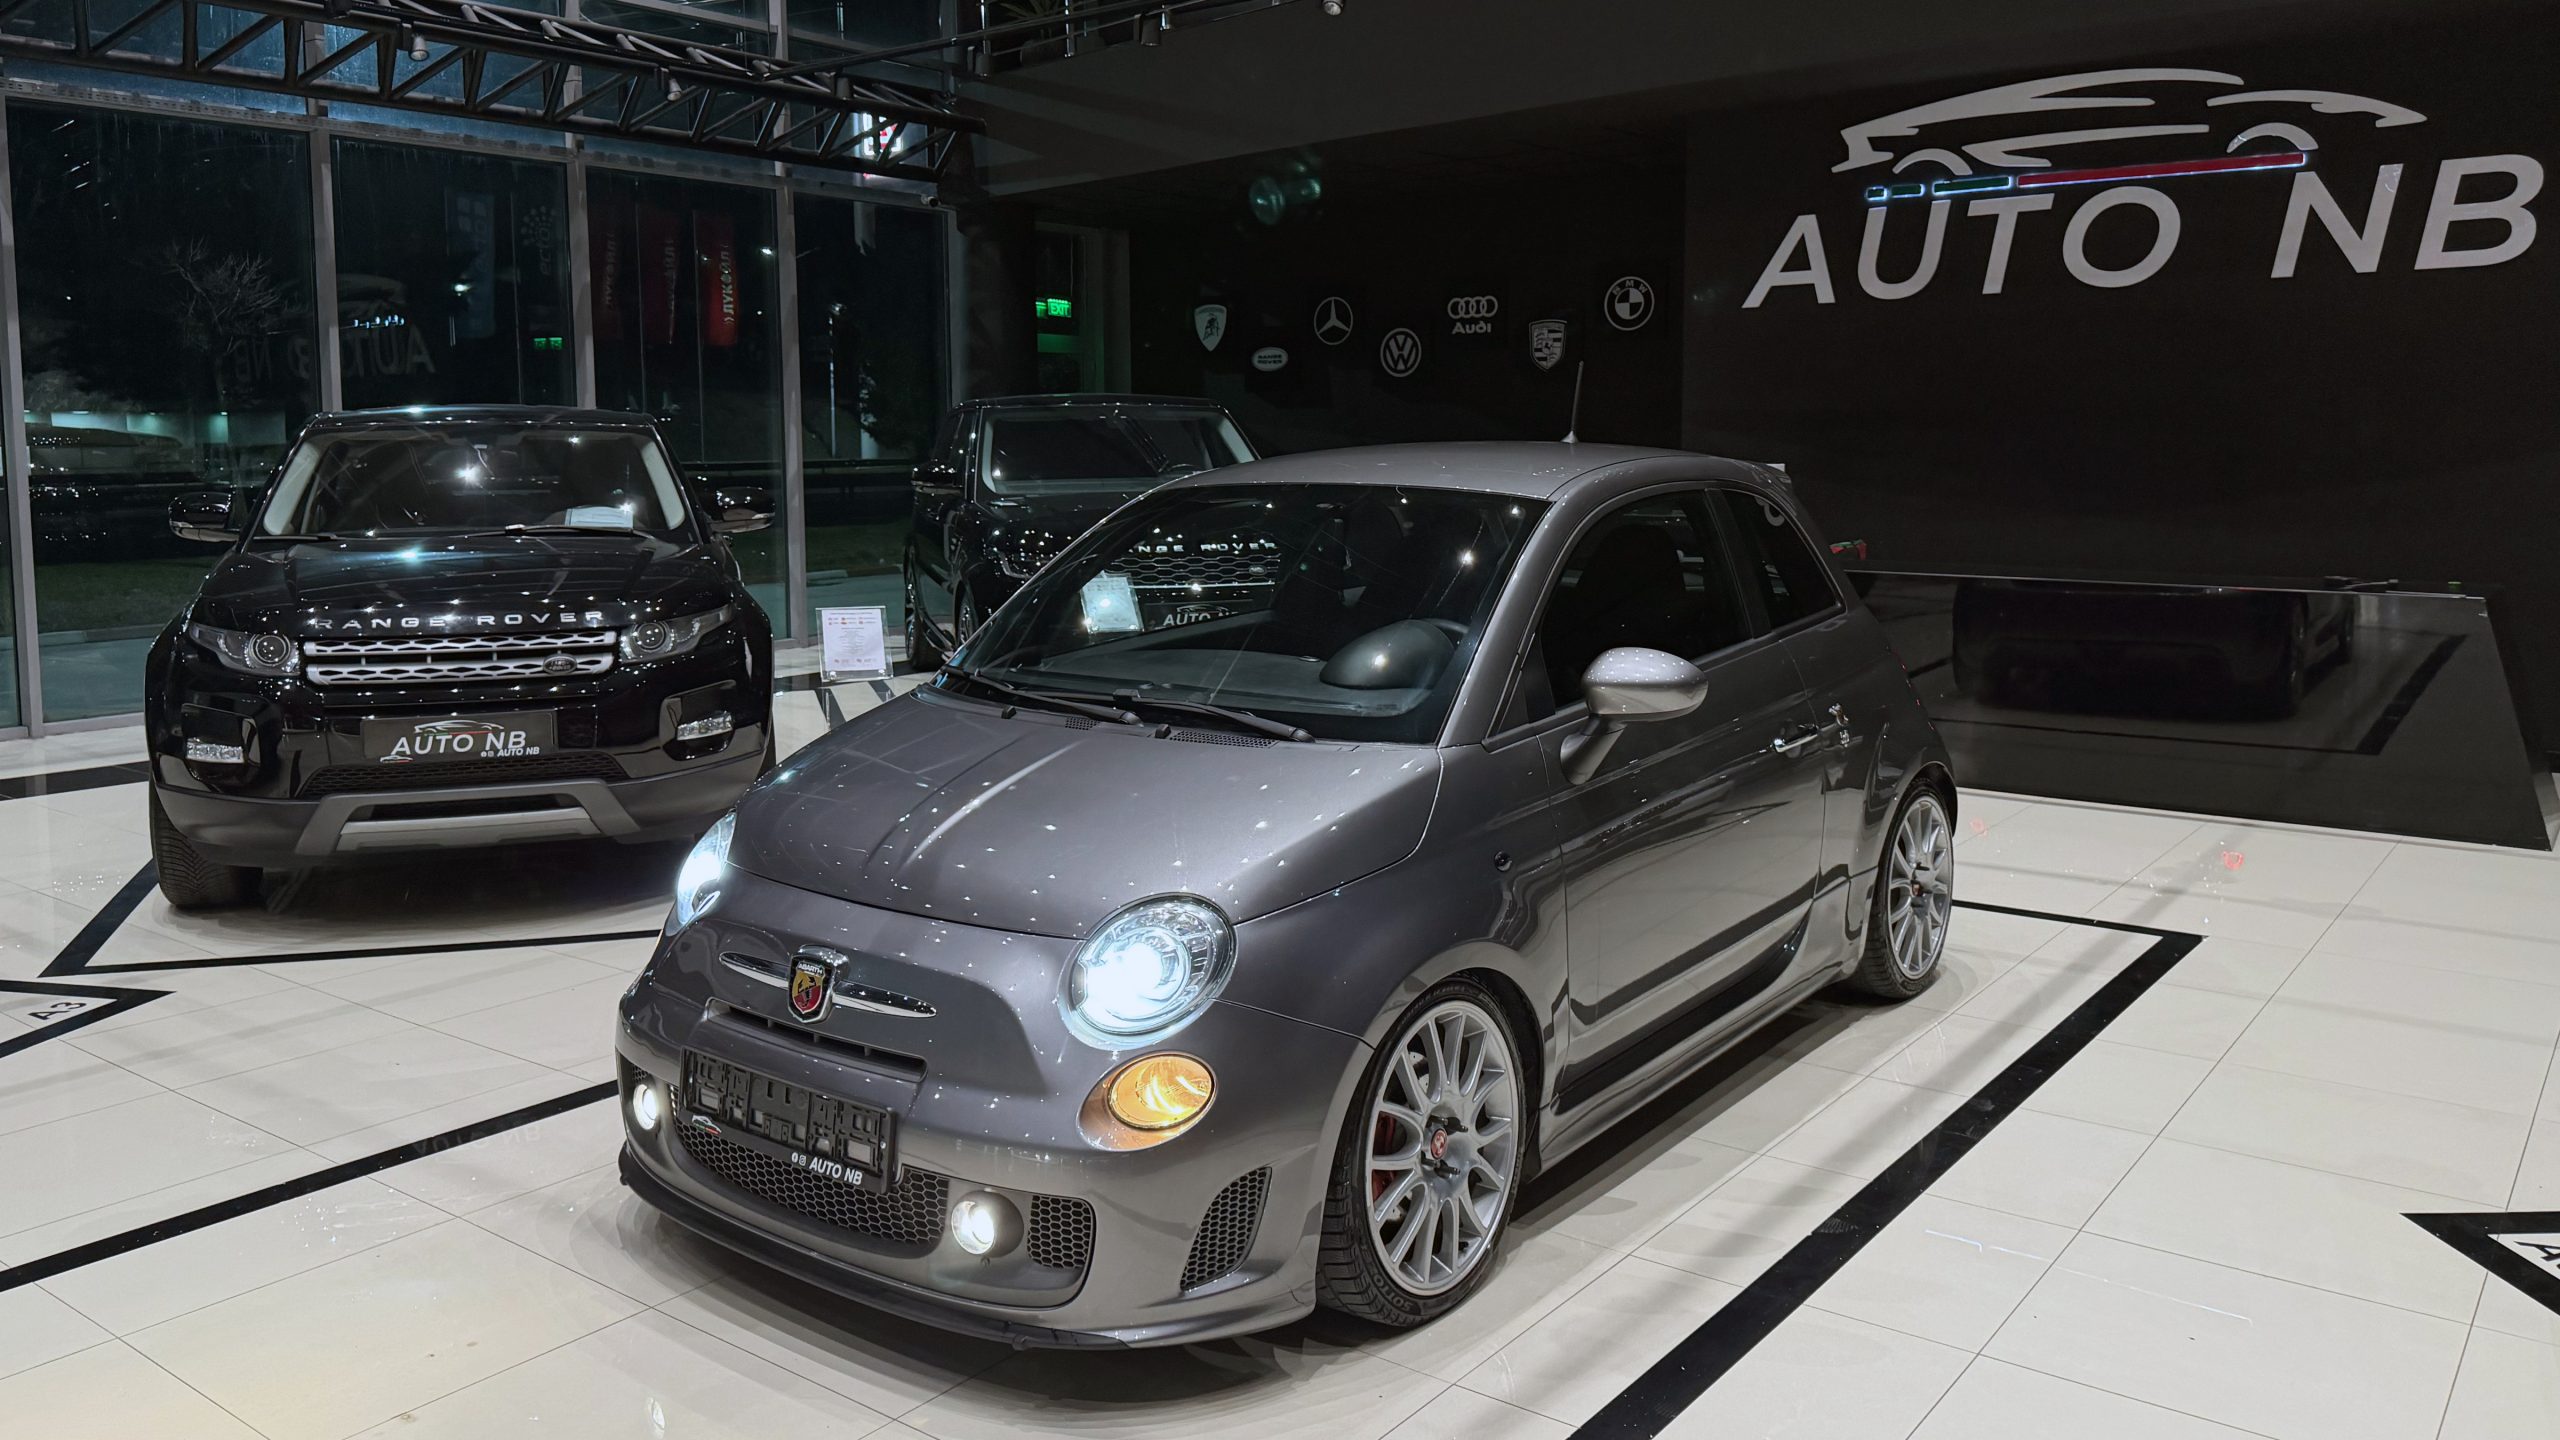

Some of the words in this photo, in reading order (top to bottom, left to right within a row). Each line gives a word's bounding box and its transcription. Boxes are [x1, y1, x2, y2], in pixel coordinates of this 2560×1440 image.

[1741, 185, 2182, 309] AUTO
[2270, 152, 2545, 279] NB
[1611, 279, 1650, 297] BMW
[1050, 303, 1070, 316] EXIT
[1451, 321, 1492, 335] Audi
[1200, 542, 1278, 552] ROVER
[312, 617, 446, 630] RANGE
[476, 610, 604, 626] ROVER
[391, 734, 475, 756] AUTO
[485, 730, 527, 752] NB
[497, 747, 524, 758] AUTO
[525, 745, 540, 756] NB
[798, 963, 823, 975] ABARTH
[28, 1002, 87, 1020] A3
[809, 1157, 842, 1178] AUTO
[844, 1168, 863, 1185] NB
